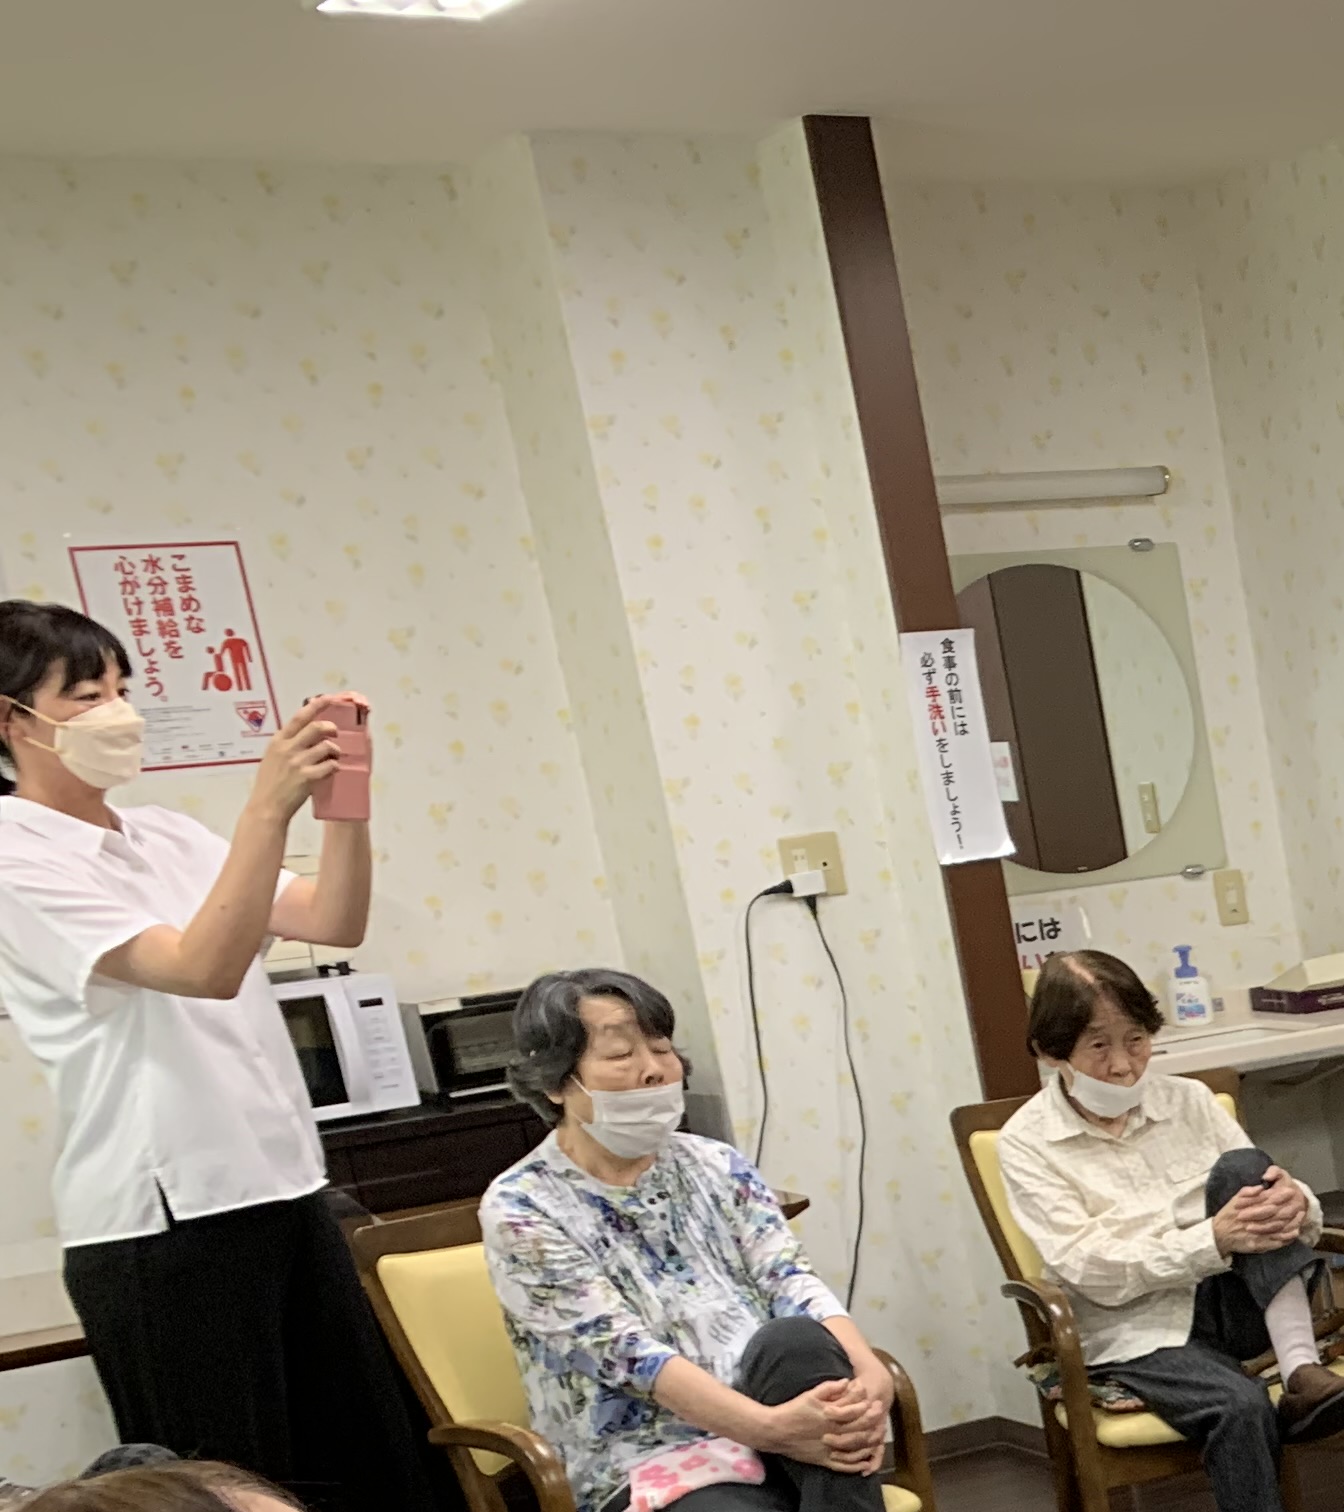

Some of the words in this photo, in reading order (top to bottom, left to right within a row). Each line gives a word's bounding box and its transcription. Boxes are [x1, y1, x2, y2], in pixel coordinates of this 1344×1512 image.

[113, 555, 169, 703] 心がけましょう。
[141, 553, 184, 660] 水分補給を
[170, 553, 206, 635] こまめな
[939, 637, 970, 737] 食事の前には
[1014, 917, 1062, 944] には
